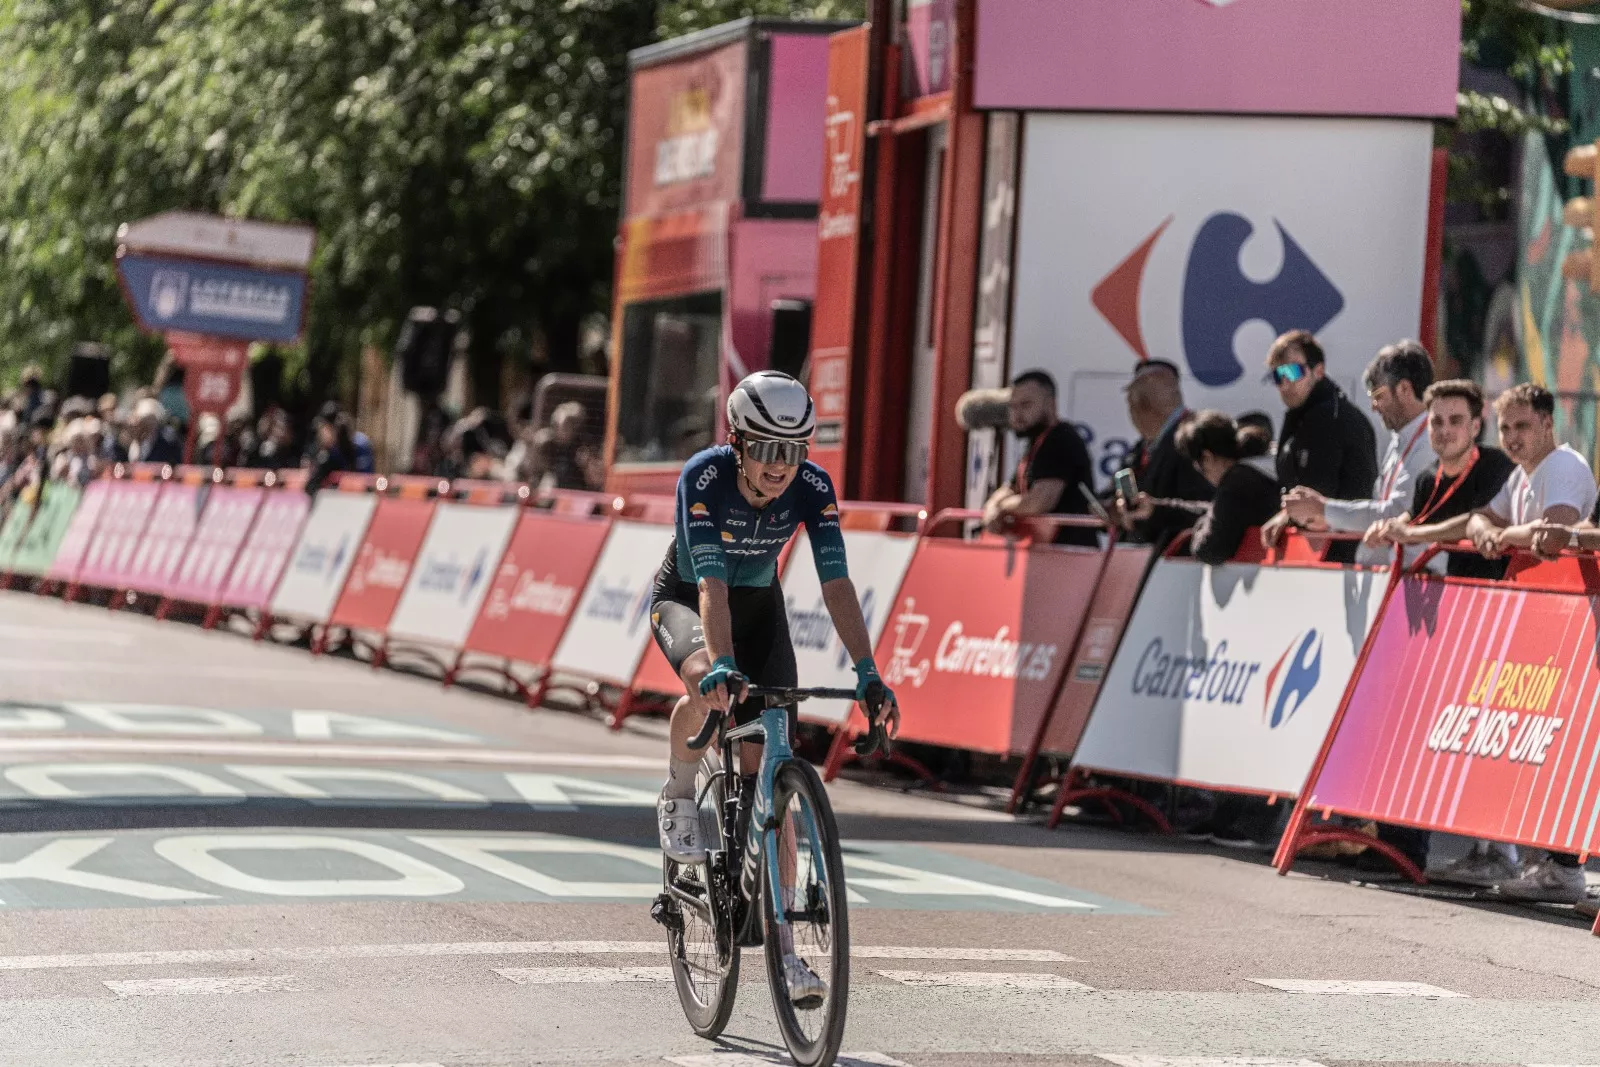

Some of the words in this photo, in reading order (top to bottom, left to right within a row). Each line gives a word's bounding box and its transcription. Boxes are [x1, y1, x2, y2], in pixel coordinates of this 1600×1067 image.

[802, 469, 829, 493] coop
[1130, 635, 1262, 705] Carrefour
[1467, 659, 1498, 705] LA
[1489, 655, 1562, 713] PASIÓN
[1428, 703, 1481, 754] QUE
[1465, 708, 1520, 760] NOS
[1508, 713, 1564, 766] UNE
